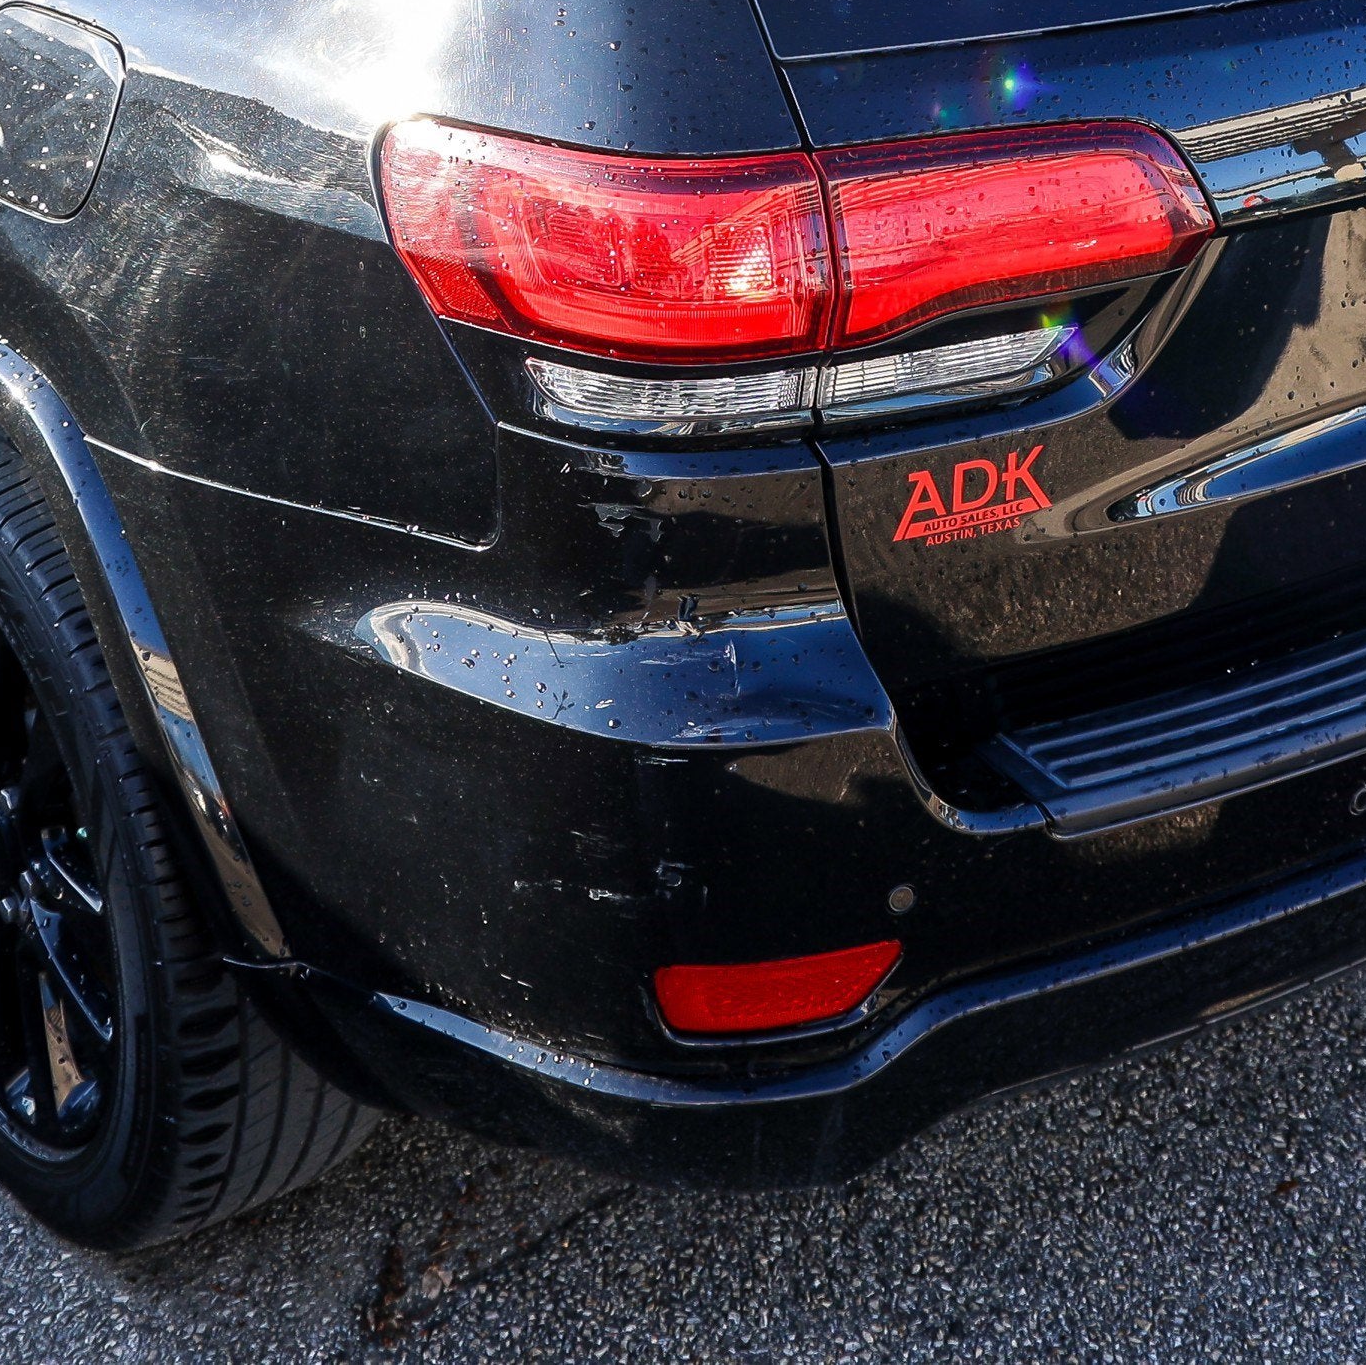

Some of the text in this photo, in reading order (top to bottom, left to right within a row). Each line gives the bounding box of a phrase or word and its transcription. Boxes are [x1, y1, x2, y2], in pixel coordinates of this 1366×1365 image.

[893, 444, 1053, 541] ADK
[923, 518, 957, 532] AUTO
[1003, 502, 1023, 515] LLC
[926, 517, 1021, 546] AUSTIN, TEXAS
